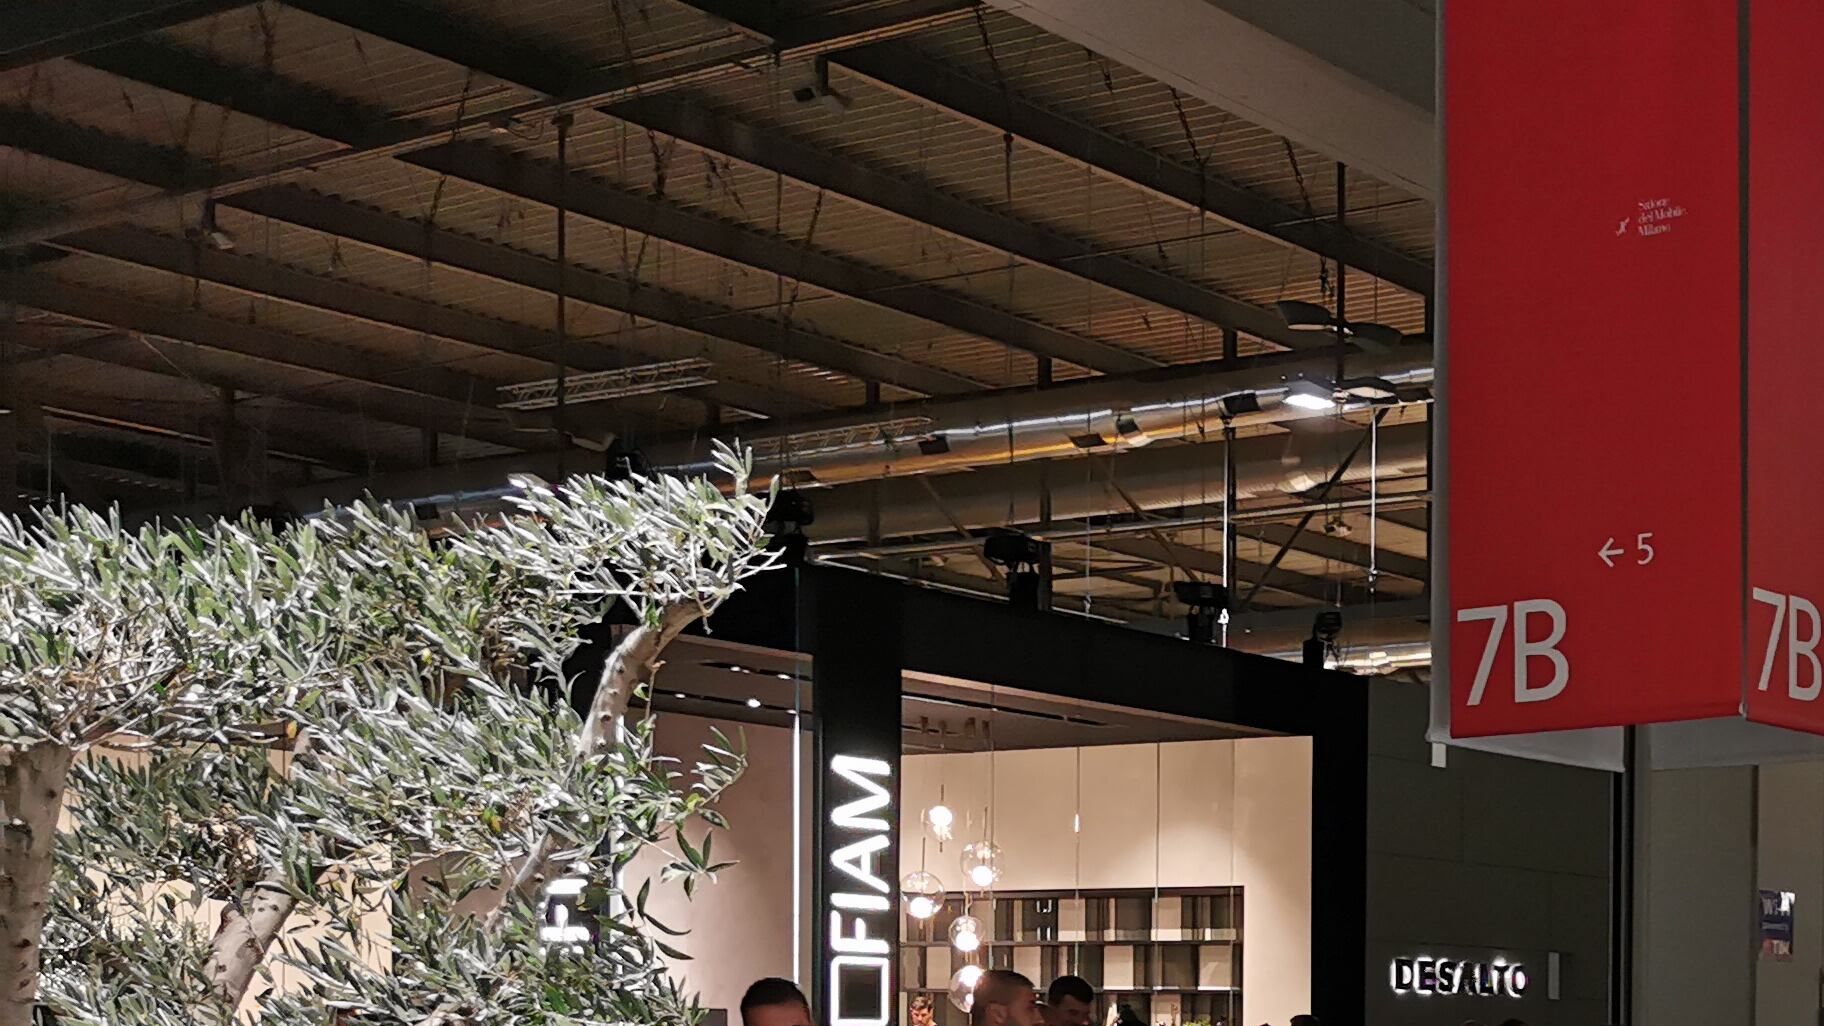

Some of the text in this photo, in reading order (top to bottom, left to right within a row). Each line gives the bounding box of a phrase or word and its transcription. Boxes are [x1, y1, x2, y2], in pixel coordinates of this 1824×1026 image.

[1636, 532, 1654, 565] 5
[1457, 598, 1570, 706] 7B
[1752, 587, 1822, 701] 7B
[830, 754, 891, 954] FIAM
[1390, 956, 1529, 998] DESALTO
